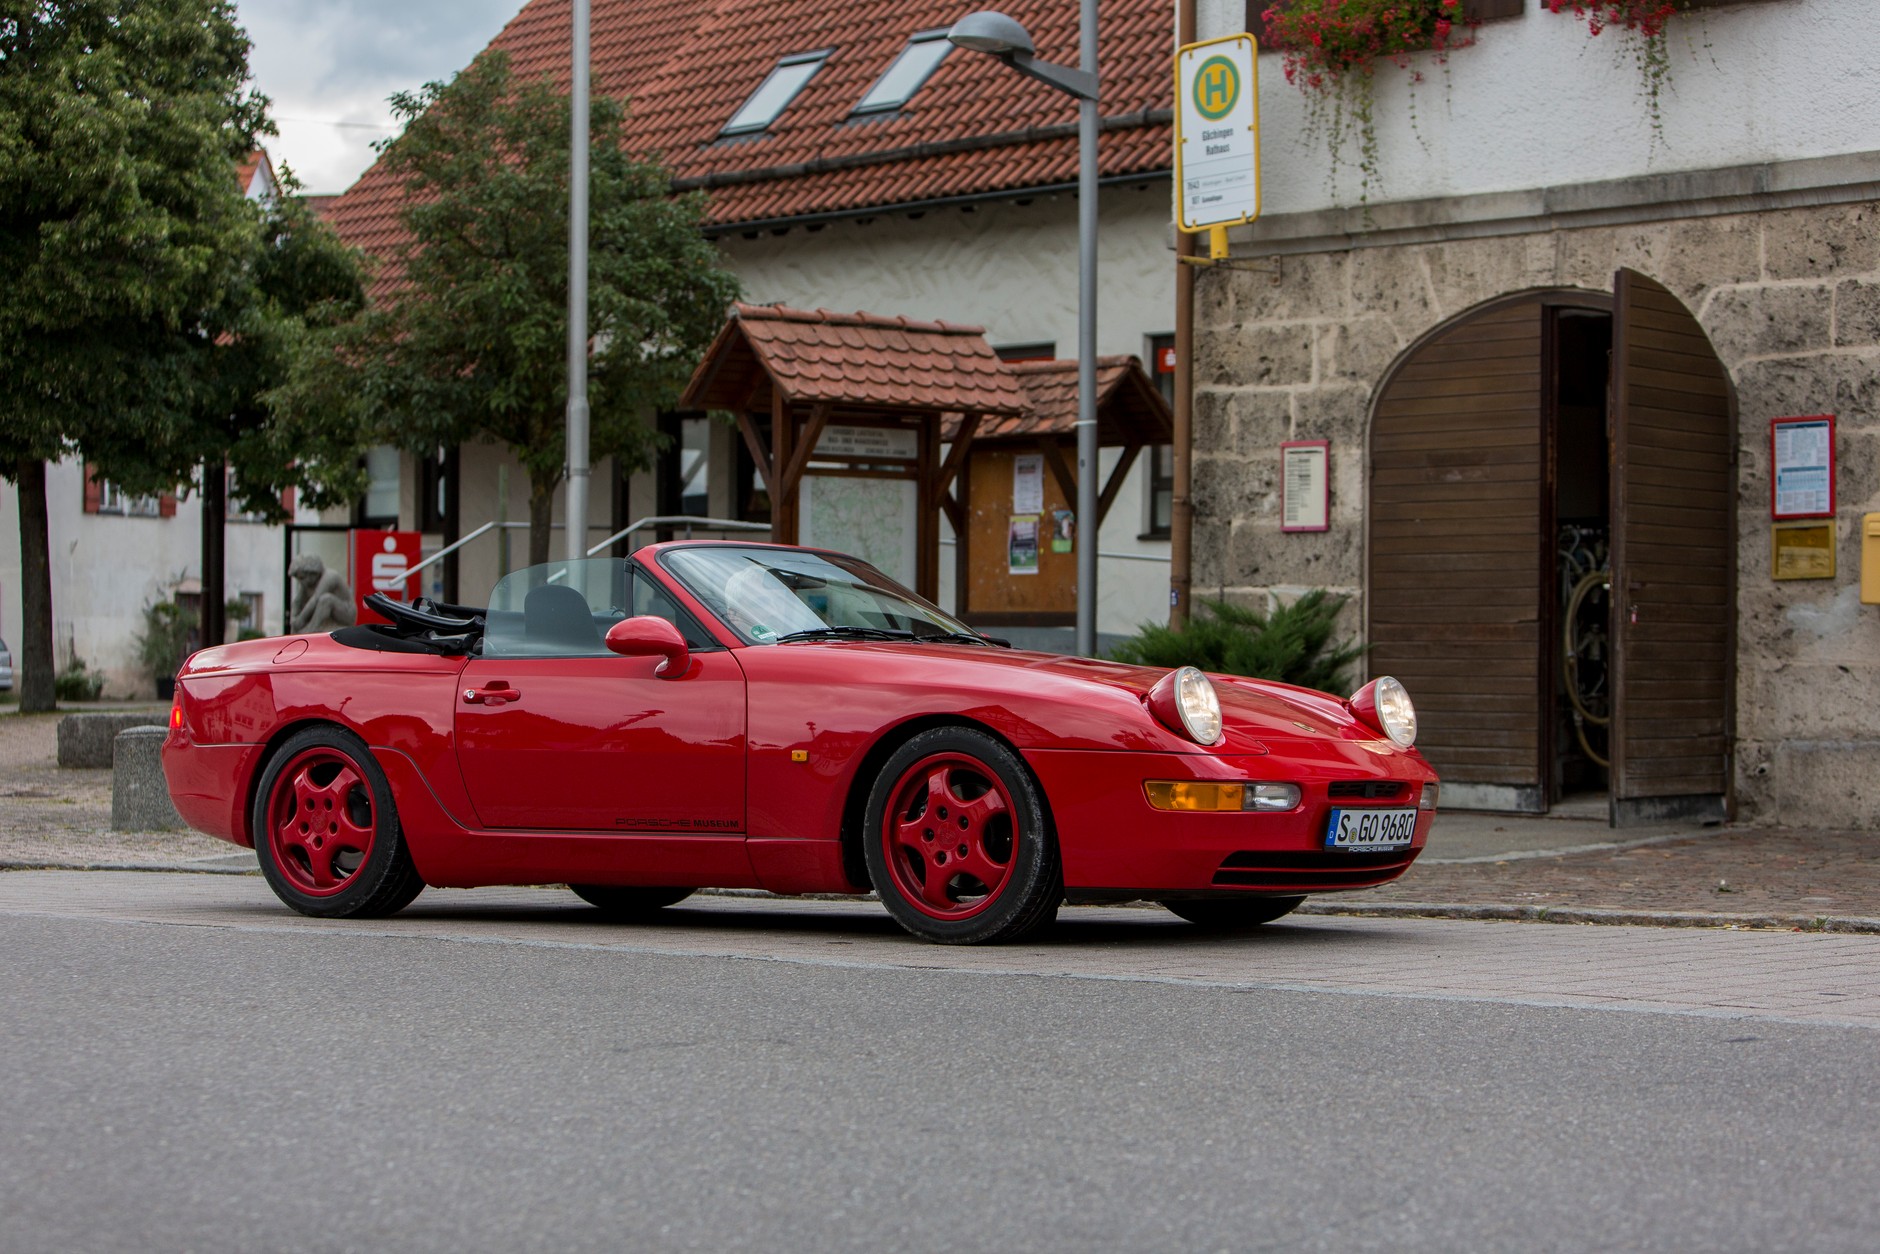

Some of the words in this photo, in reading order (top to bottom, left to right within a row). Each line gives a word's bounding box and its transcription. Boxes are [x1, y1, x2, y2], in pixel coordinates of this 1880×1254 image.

[1205, 69, 1227, 106] H
[1206, 144, 1230, 155] Rathaus
[615, 818, 691, 827] PORSCHE
[693, 819, 739, 828] MUSEUM
[1337, 814, 1351, 842] S
[1358, 814, 1379, 842] GO
[1380, 813, 1414, 842] 9680
